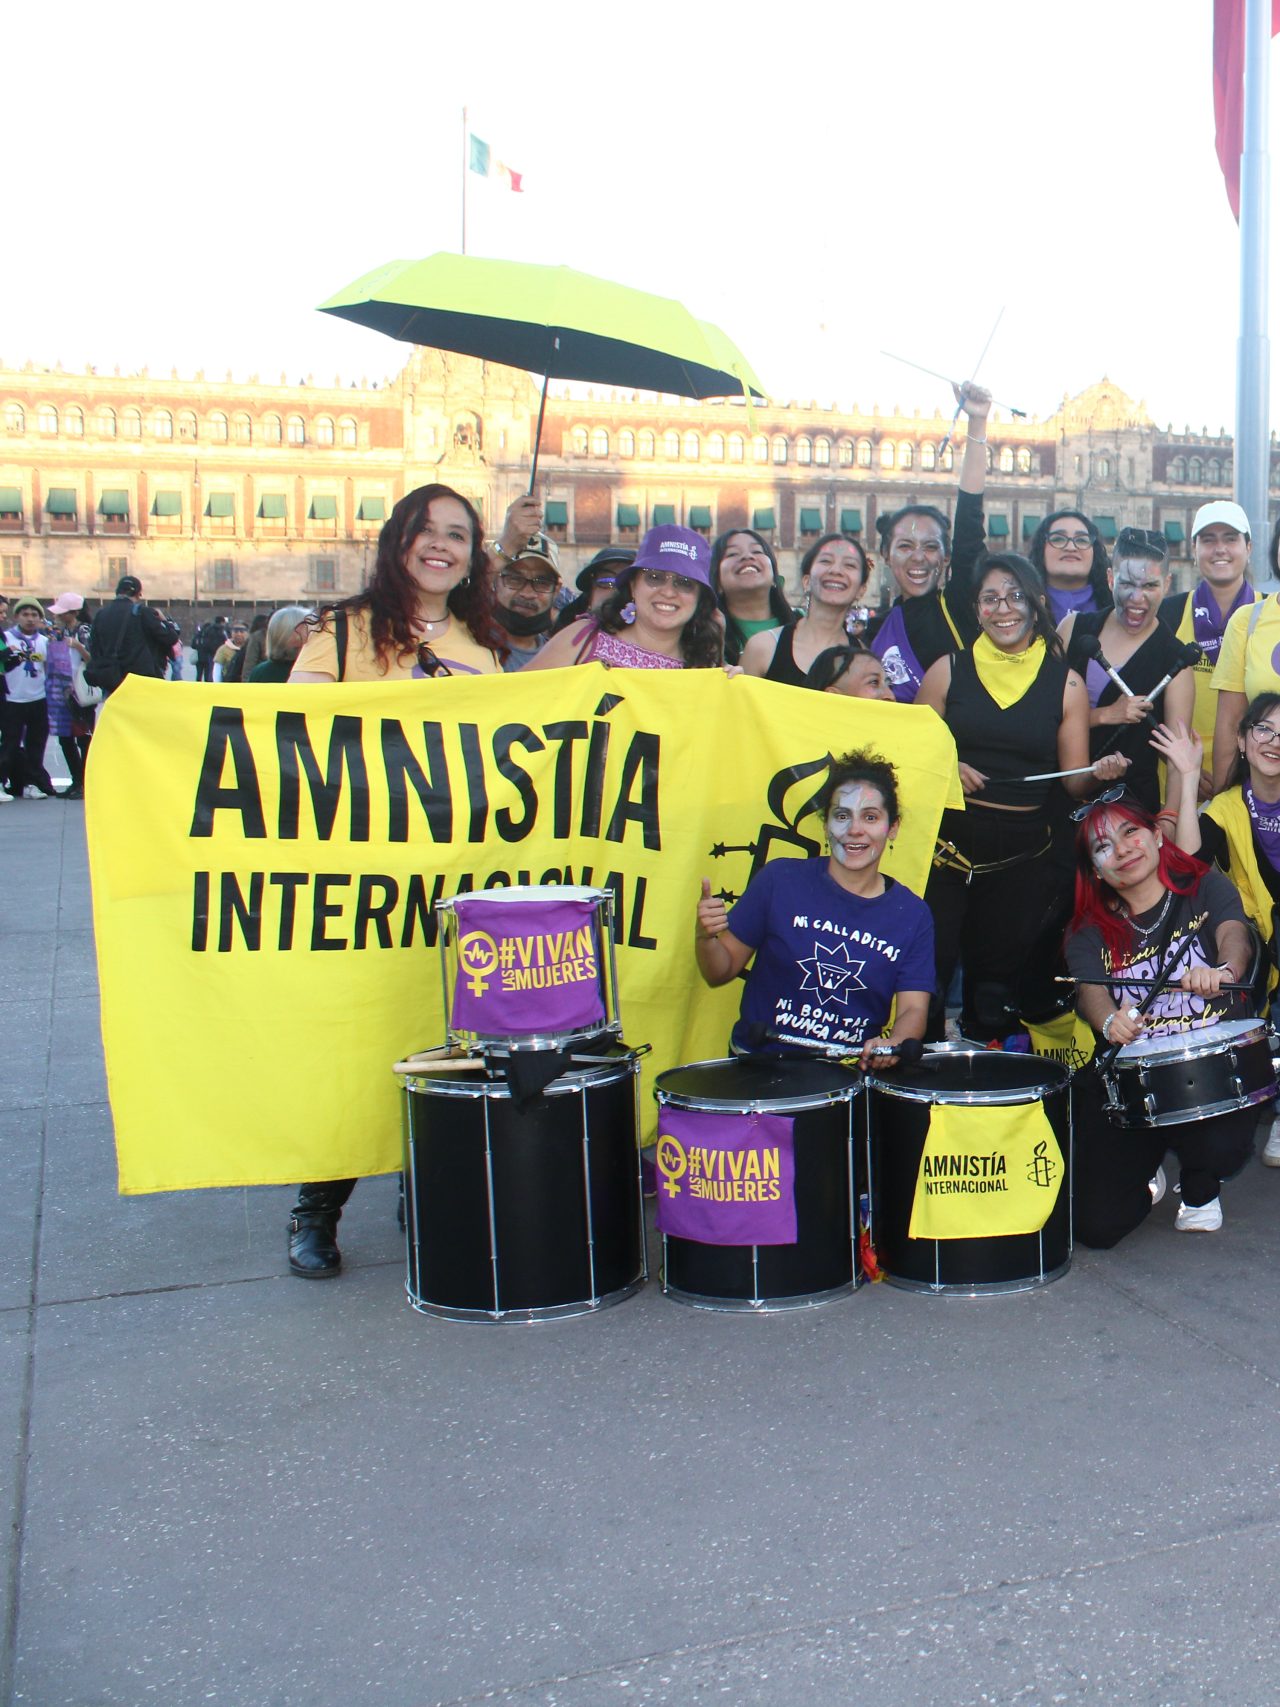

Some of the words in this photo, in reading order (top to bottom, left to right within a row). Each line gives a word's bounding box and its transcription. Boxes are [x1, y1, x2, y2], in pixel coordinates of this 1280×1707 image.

[189, 692, 662, 851] AMNISTÍA
[191, 866, 657, 953] INTERNAL
[499, 926, 594, 968] #VIVAN
[502, 969, 515, 991] LAS
[514, 957, 597, 990] MUJERES
[775, 1013, 830, 1040] NUNCA
[688, 1147, 780, 1180] #VIVAN
[923, 1152, 1007, 1177] AMNISTÍA
[689, 1175, 701, 1197] LAS
[701, 1179, 781, 1201] MUJERES
